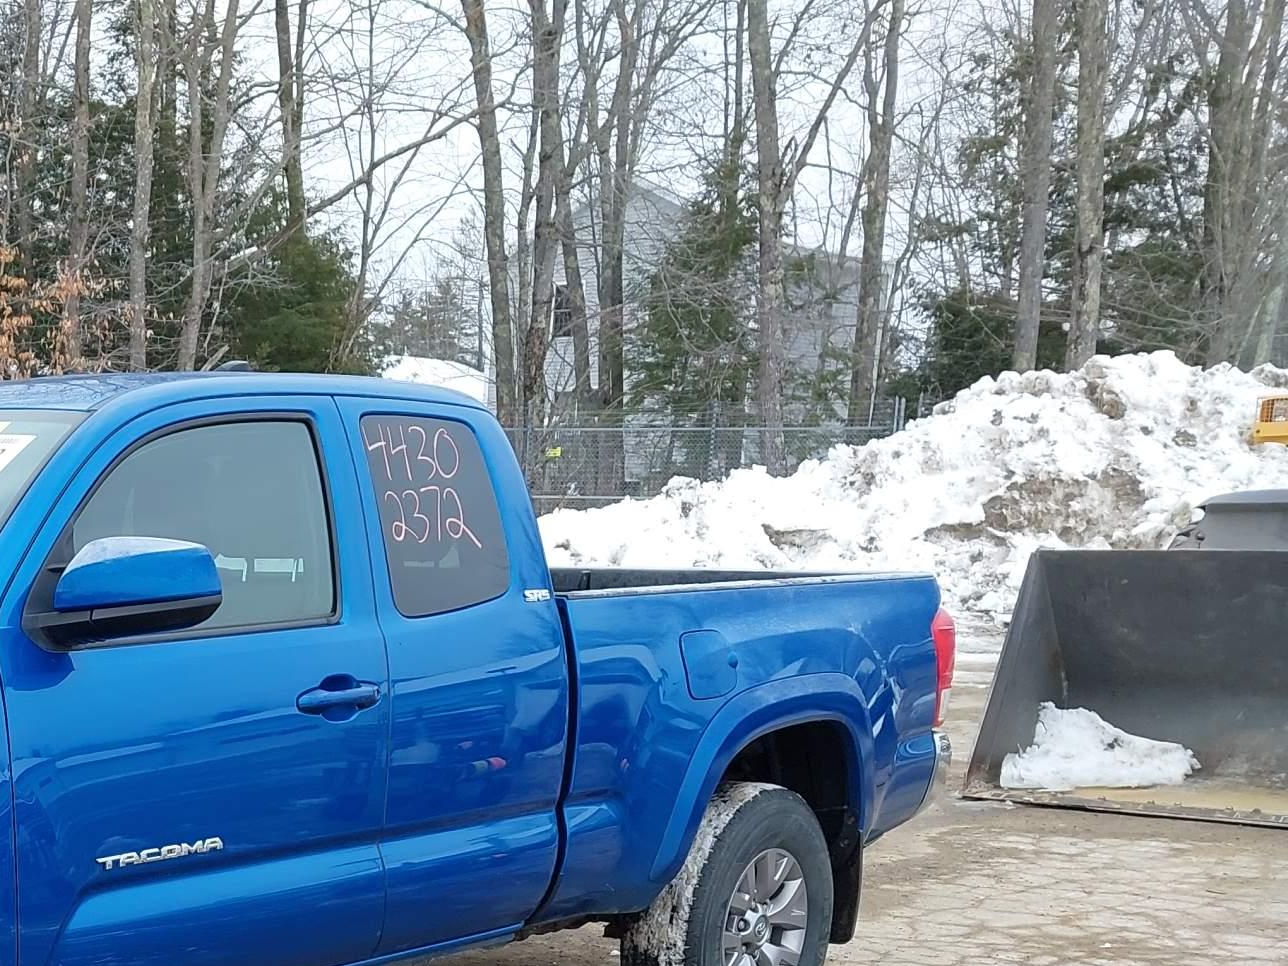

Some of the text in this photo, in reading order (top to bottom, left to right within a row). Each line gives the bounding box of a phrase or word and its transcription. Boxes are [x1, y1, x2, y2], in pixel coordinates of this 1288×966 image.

[361, 423, 460, 481] 4430
[384, 485, 482, 549] 2372
[95, 836, 224, 870] TACOMA
